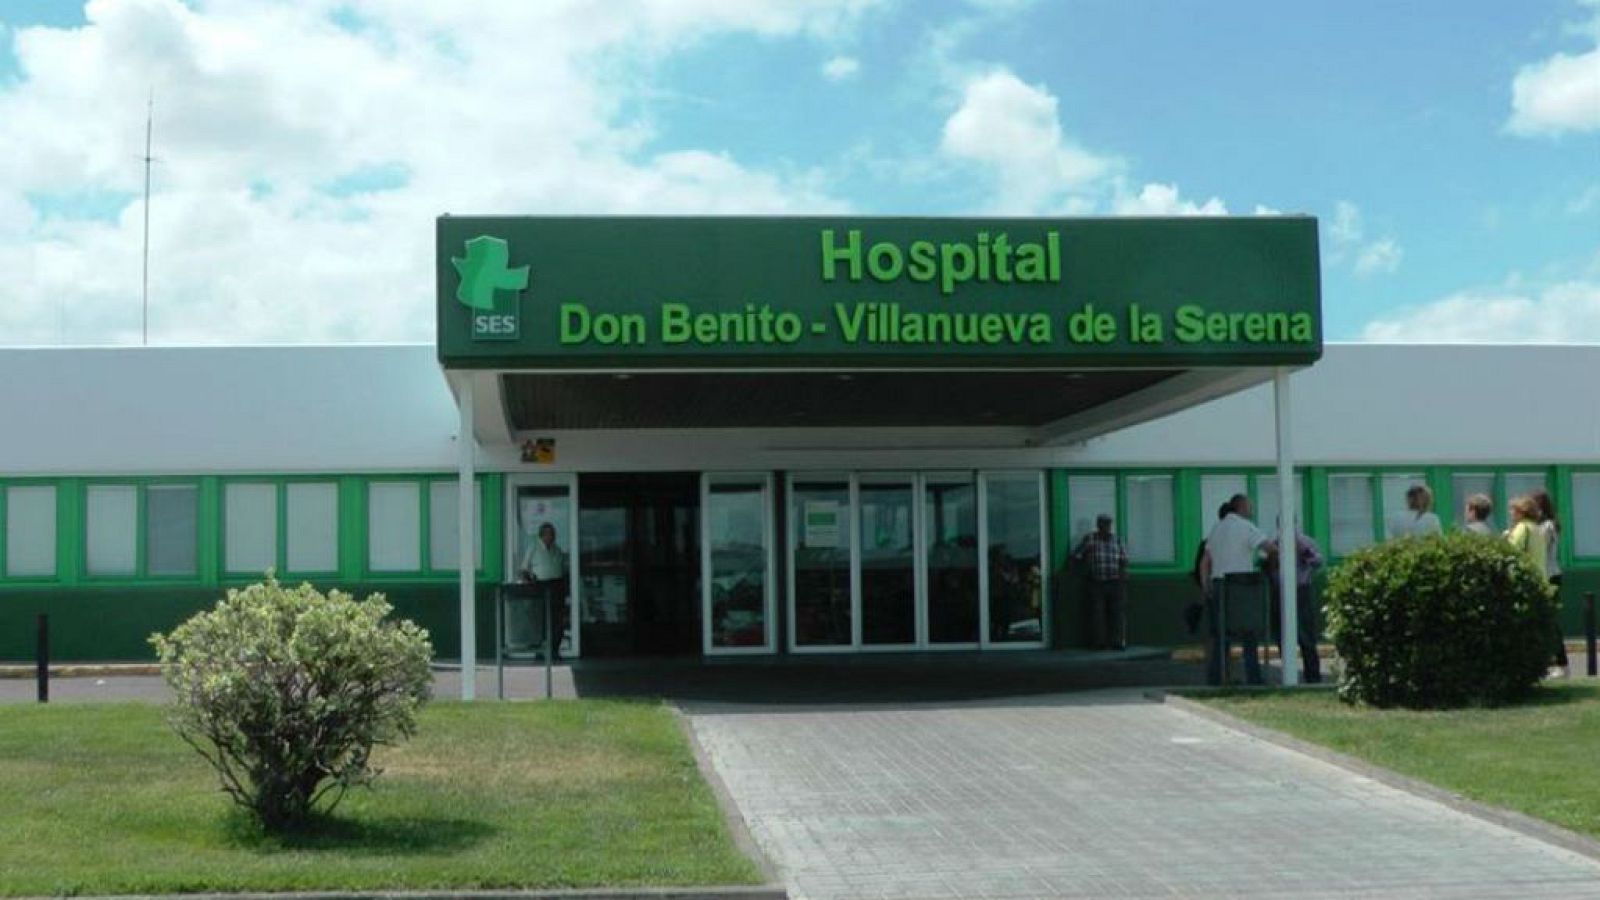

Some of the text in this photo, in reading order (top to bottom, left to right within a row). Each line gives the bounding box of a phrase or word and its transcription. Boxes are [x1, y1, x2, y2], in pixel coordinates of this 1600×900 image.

[822, 230, 1060, 293] Hospital
[475, 315, 515, 333] SES
[561, 303, 1312, 343] Don Benito - Villanueva de la Serena
